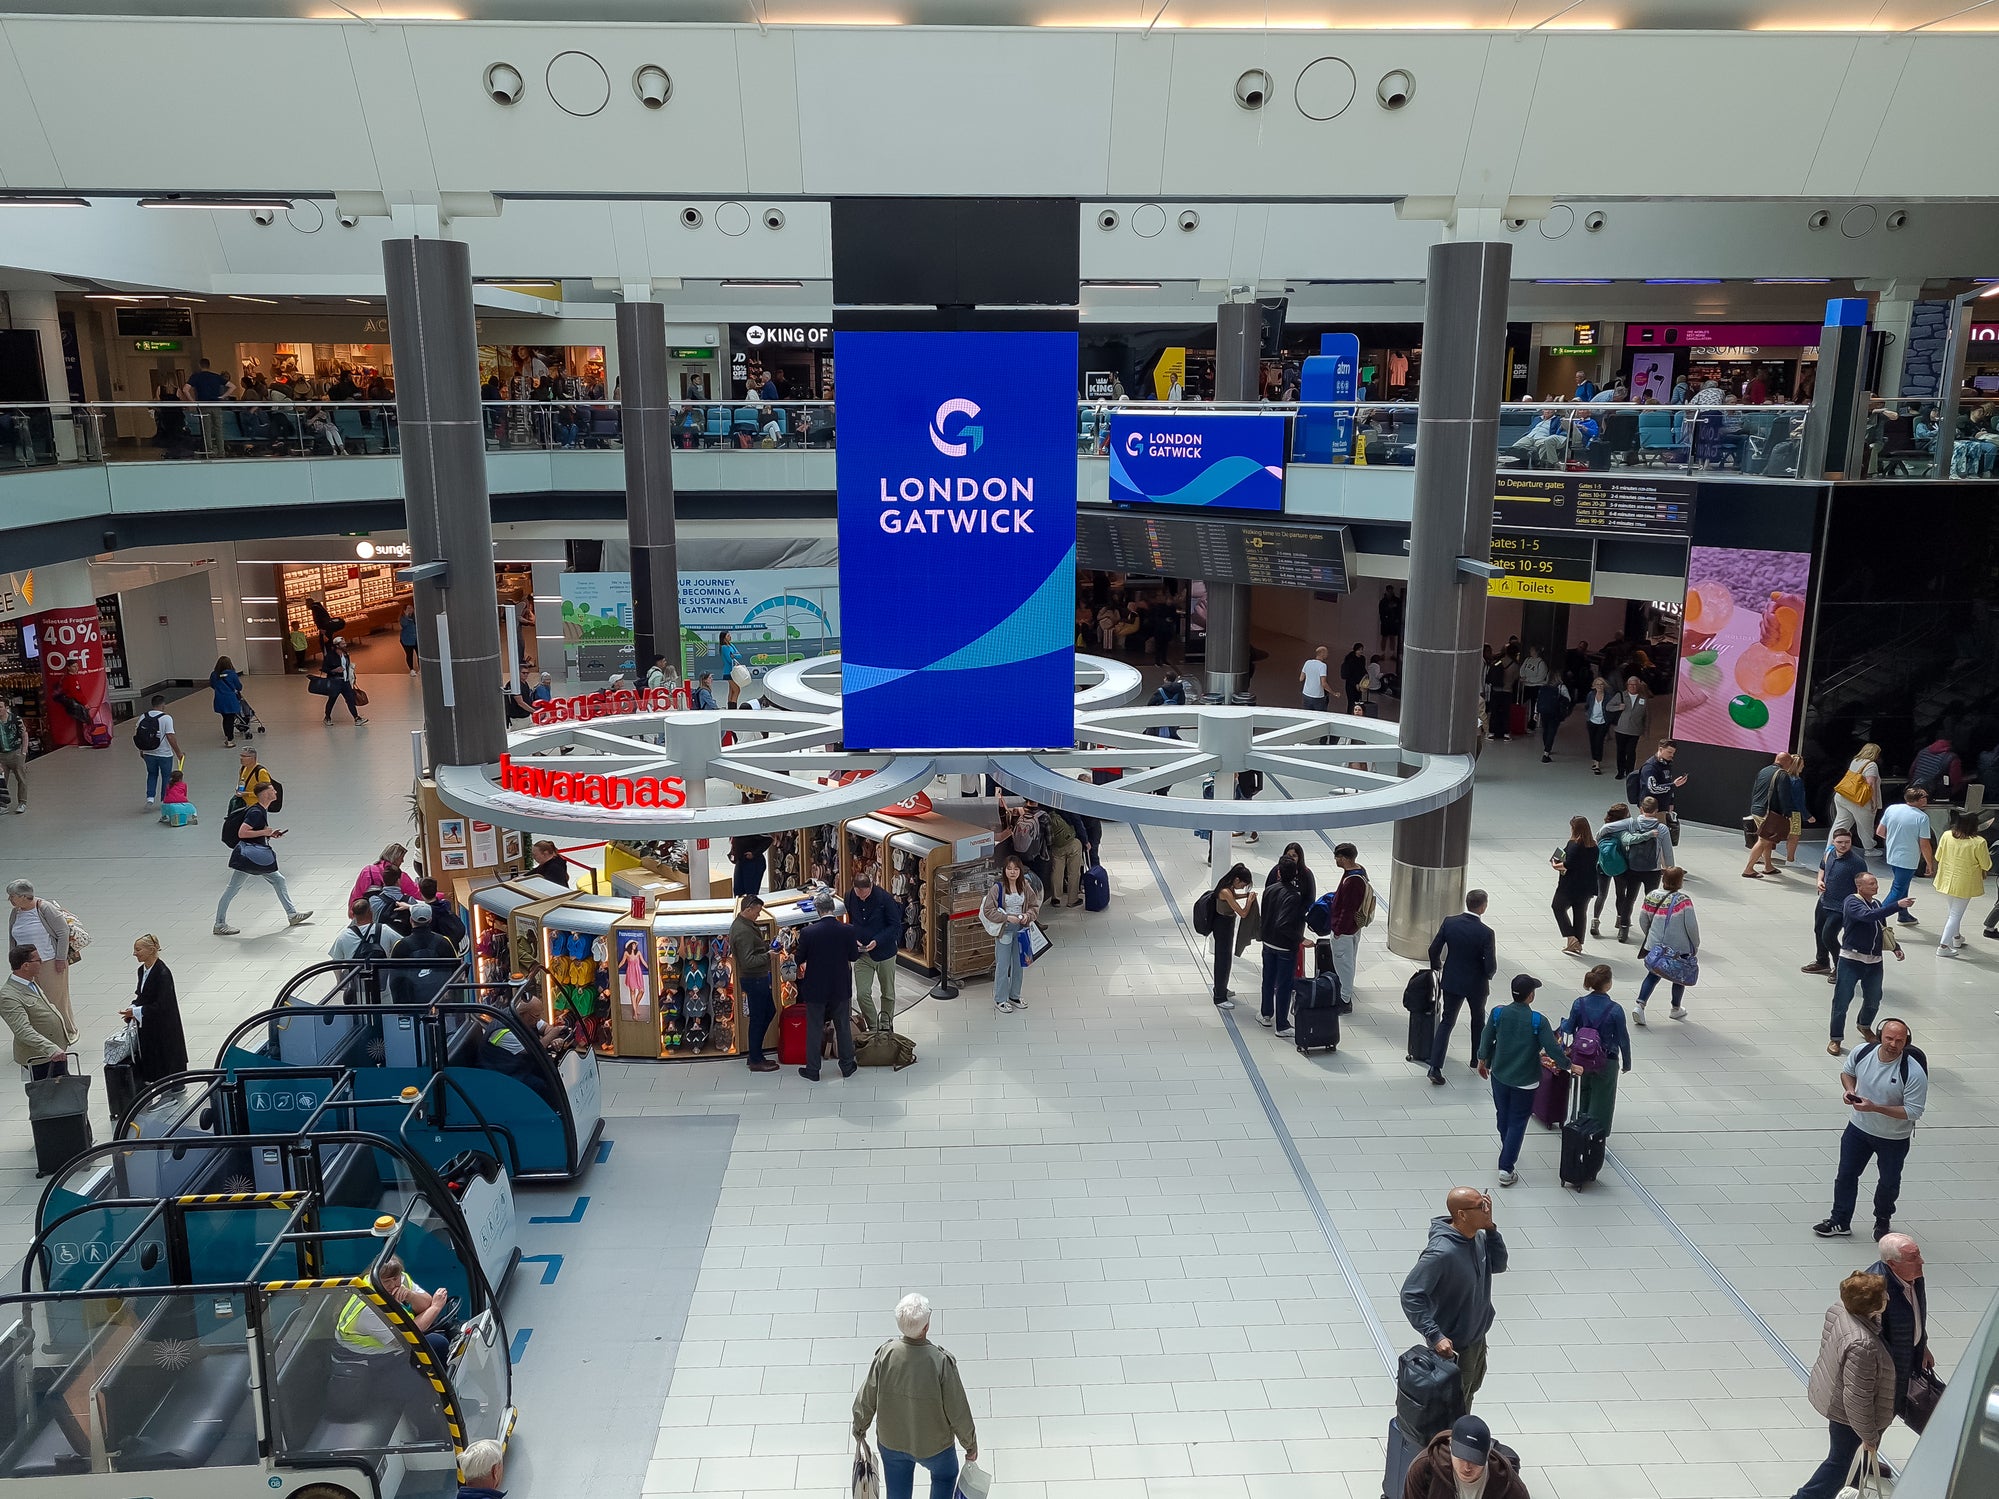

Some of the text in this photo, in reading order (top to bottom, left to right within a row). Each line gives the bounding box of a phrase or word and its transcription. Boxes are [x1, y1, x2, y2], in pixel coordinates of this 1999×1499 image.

[767, 328, 828, 342] KING OF
[732, 352, 746, 363] JD
[1337, 362, 1350, 374] atm
[1089, 384, 1113, 393] KING
[1149, 433, 1202, 445] LONDON
[1149, 446, 1202, 458] GATWICK
[881, 477, 1033, 502] LONDON
[1507, 479, 1543, 489] Departure
[1545, 481, 1565, 490] gates
[880, 509, 1034, 533] GATWICK
[1519, 559, 1553, 573] 10-95
[1516, 580, 1554, 594] Toilets
[689, 597, 748, 605] SUSTAINABLE
[43, 622, 98, 645] 40%
[47, 648, 90, 671] Off
[500, 752, 687, 810] havaianas
